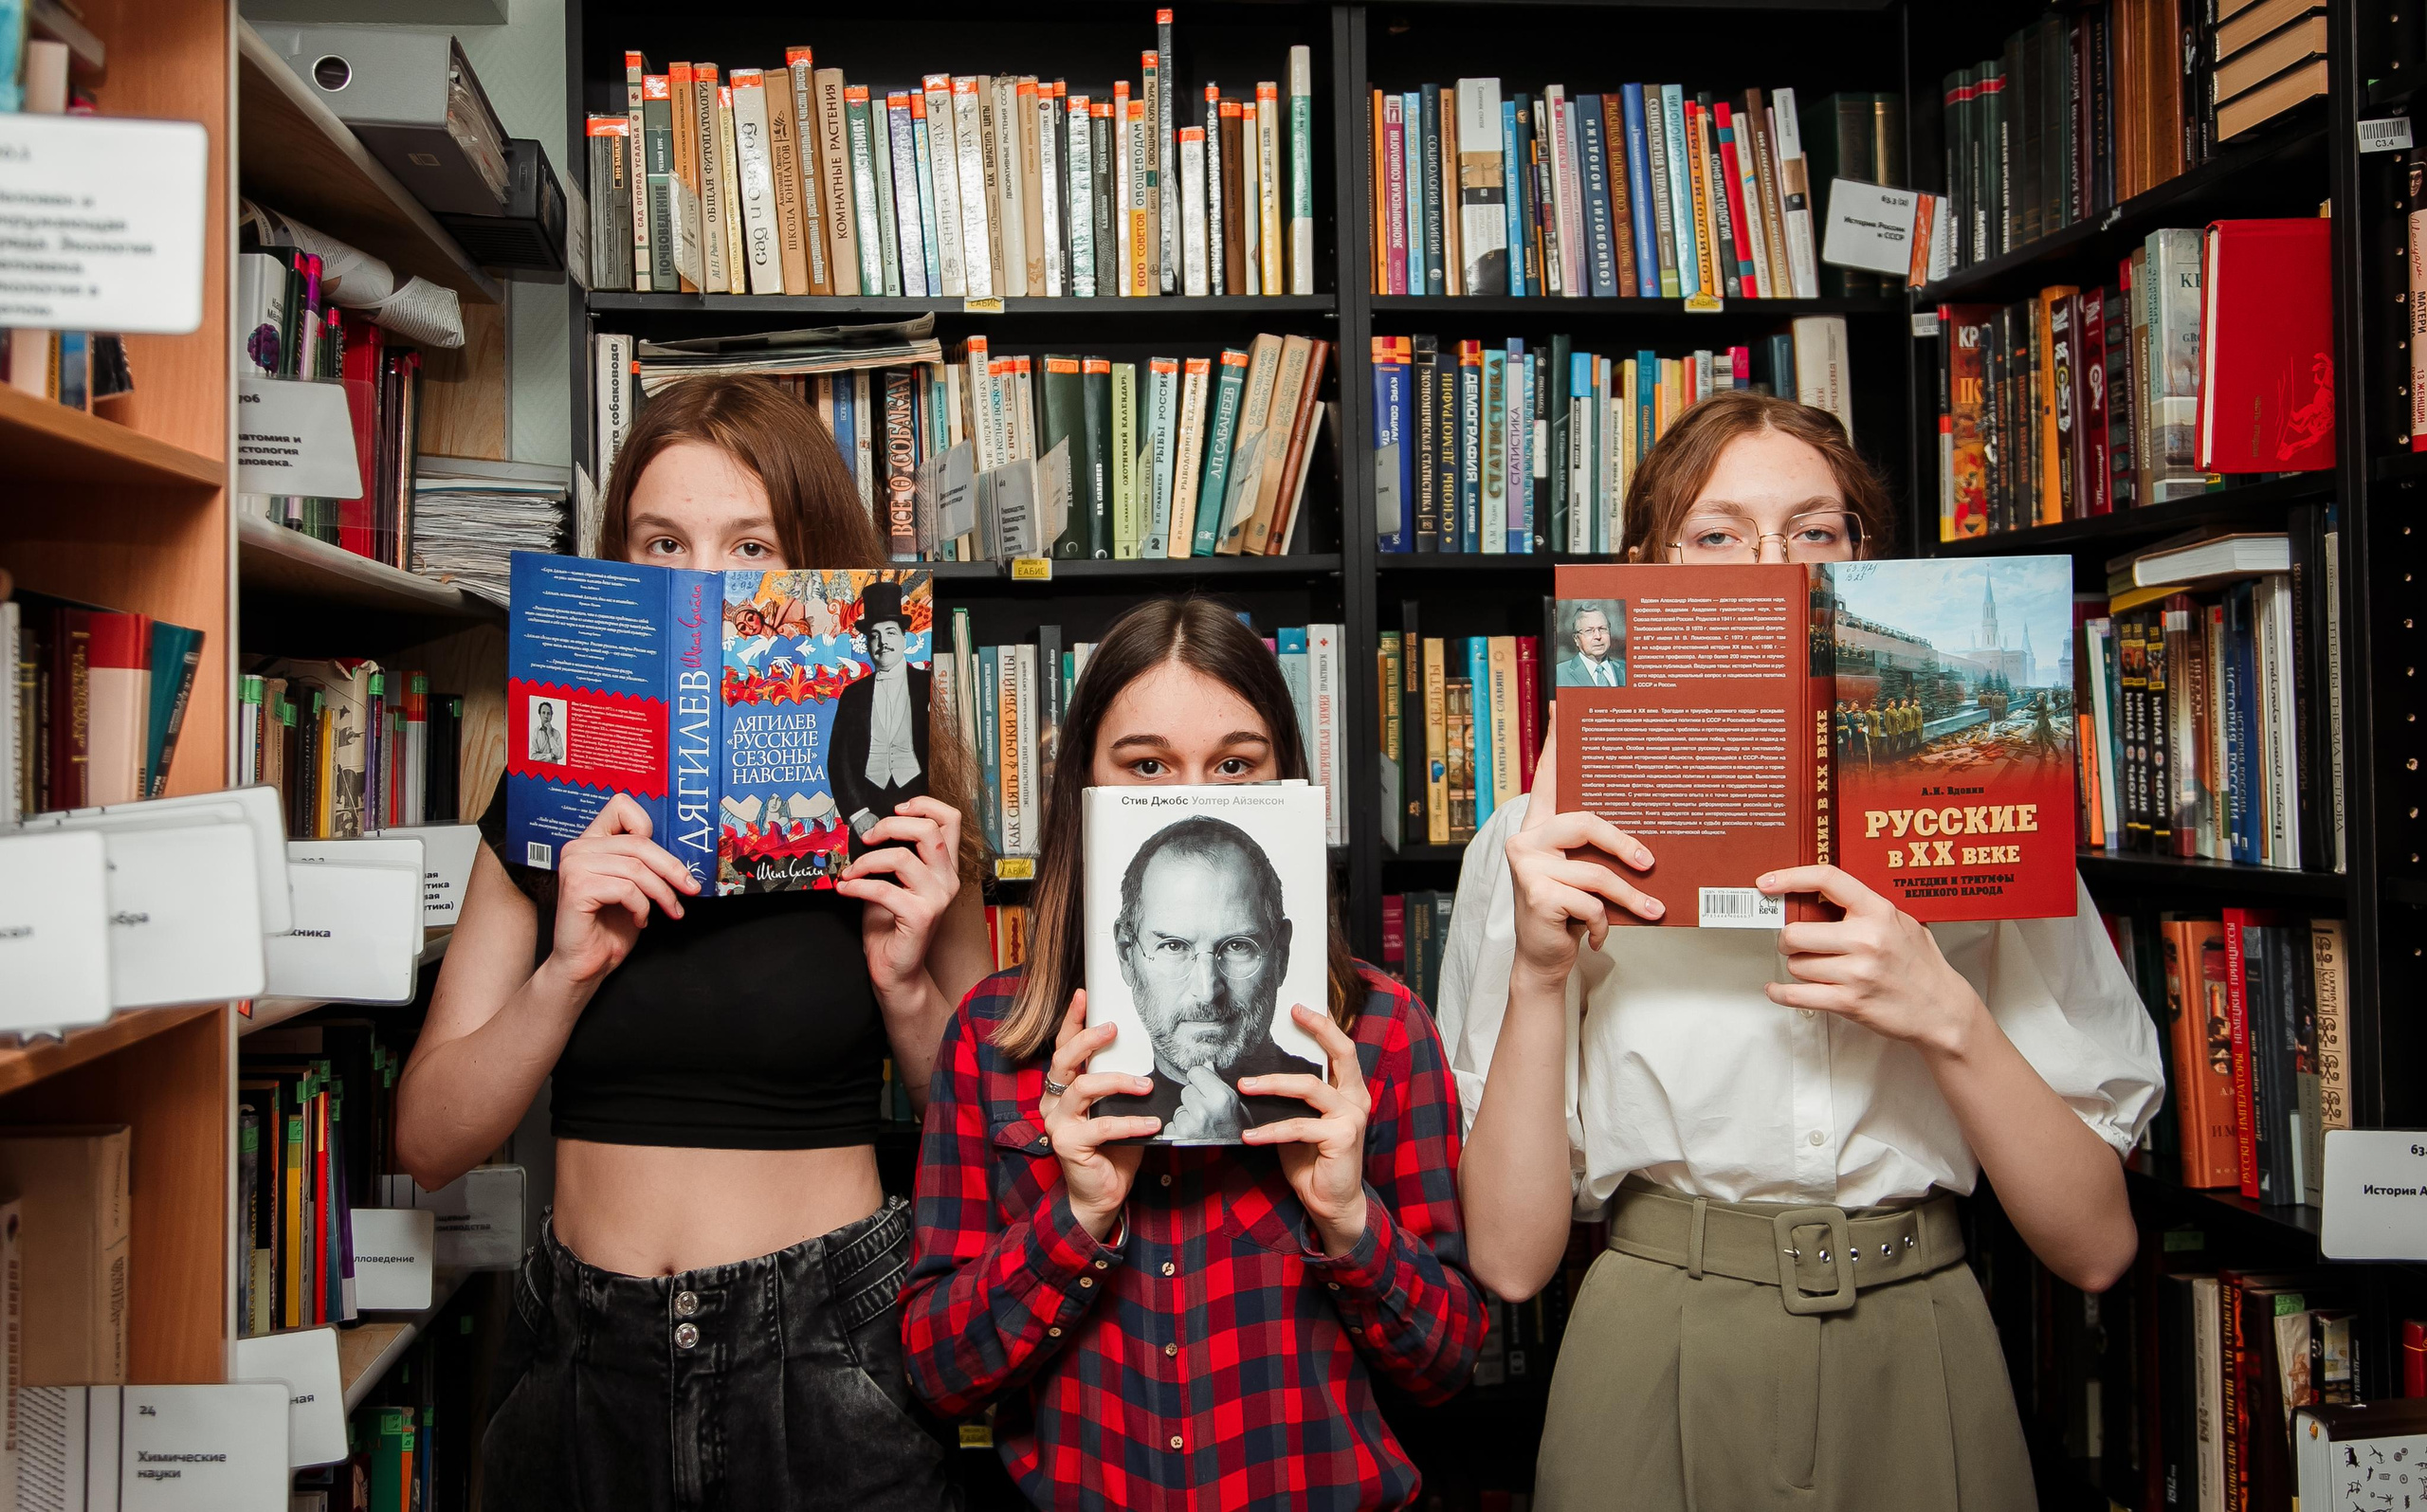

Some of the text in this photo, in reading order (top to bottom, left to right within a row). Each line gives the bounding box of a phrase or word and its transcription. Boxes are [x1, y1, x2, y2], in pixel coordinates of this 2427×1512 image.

[632, 127, 641, 168] УСАДЬБА
[982, 105, 995, 187] КАК ВЫРАСТИТЬ ЦВЕТЫ
[1001, 109, 1010, 143] РАСТЕНИЯ
[825, 84, 848, 239] КОМНАТНЫЕ РАСТЕНИЯ
[1002, 146, 1013, 199] ДЕКОРАТИВНЫЕ
[1608, 101, 1627, 211] СОЦИОЛОГИЯ КУЛЬТУРЫ
[1648, 98, 1671, 231] СОЦИОЛОГИЯ УПРАВЛЕНИЯ
[705, 178, 717, 223] ОБЩАЯ
[776, 172, 785, 206] Анатолий
[781, 145, 797, 250] ШКОЛА ЮННАТОВ
[1134, 123, 1146, 287] 600 СОВЕТОВ ОВОЩЕВОДАМ
[1390, 131, 1403, 248] ЭКОНОМИЧЕСКАЯ СОЦИОЛОГИЯ
[1427, 135, 1440, 254] СОЦИОЛОГИЯ РЕЛИГИИ
[1586, 118, 1611, 286] СОЦИОЛОГИЯ МОЛОДЕЖИ
[1688, 115, 1710, 284] СОЦИОЛОГИЯ СЕМЬИ
[1710, 154, 1732, 240] КОНФЛИКТОЛОГИЯ
[655, 186, 671, 276] ПОЧВОВЕДЕНИЕ
[752, 227, 769, 265] сад
[2417, 291, 2426, 334] МАТЕРИ
[609, 343, 619, 426] собаковода
[1250, 348, 1268, 416] ВСЕХ СОЗДАНИЯХ
[1267, 347, 1277, 377] МАЛЫХ
[976, 351, 992, 446] МЕДОНОСНЫХ ПЧЕЛ
[1155, 372, 1168, 464] РЫБЫ РОССИИ
[1214, 387, 1235, 453] САБАНЕЕВ
[2416, 381, 2425, 423] ЖЕНЩИН
[1007, 422, 1015, 448] пчел
[1421, 369, 1433, 511] ЭКОНОМИЧЕСКАЯ СТАТИСТИКА
[1441, 373, 1455, 532] ОСНОВЫ ДЕМОГРАФИИ
[1465, 373, 1478, 483] ДЕМОГРАФИЯ
[1487, 358, 1503, 499] СТАТИСТИКА
[1510, 407, 1522, 485] СТАТИСТИКА
[238, 457, 293, 467] еловека.
[886, 377, 914, 537] ВСЕ О СОБАКАХ
[1121, 431, 1129, 485] ОХОТНИЧИЙ
[1017, 565, 1045, 575] ЕАБИС
[1151, 538, 1160, 550] 2
[2292, 562, 2304, 625] ИСТОРИЯ
[1320, 695, 1330, 725] ХИМИЯ
[1430, 664, 1442, 725] КЕЛЬТЫ
[2126, 692, 2135, 739] БУНИЧ
[727, 732, 818, 750] «РУССКИЕ
[734, 714, 816, 735] ДЯГИЛЕВ
[1002, 655, 1020, 847] КАК СНЯТЬ ОЧКИ-УБИЙЦЫ
[1817, 710, 1828, 757] ВЕКЕ
[2135, 692, 2148, 811] ИГОРЬ БУНИЧ
[2226, 666, 2240, 820] ИСТОРИЯ РОССИИ
[2328, 621, 2345, 833] ПТЕНЦЫ ГНЕЗДА ПЕТРОВА
[678, 670, 714, 853] ДЯГИЛЕВ
[732, 749, 818, 767] СЕЗОНЫ»
[732, 766, 826, 785] НАВСЕГДА
[2152, 696, 2165, 817] ИГОРЬ БУНИЧ
[1122, 795, 1285, 808] Стив Джобс Уолтер Айзексон
[1947, 786, 1984, 796] Вдовин
[2127, 764, 2137, 811] ИГОРЬ
[1865, 804, 2038, 838] РУССКИЕ
[1893, 874, 2015, 888] ТРАГЕДИИ ТРИУМФЫ
[1962, 845, 2020, 865] ВЕКЕ
[1905, 884, 2003, 899] ВЕЛИКОГО НАРОДА
[291, 926, 332, 939] хника
[2226, 922, 2252, 1184] РУССКИЕ НЕМЕЦКИЕ ПРИНЦЕССЫ
[2363, 1184, 2417, 1197] История
[354, 1253, 415, 1266] лловедение
[2222, 1285, 2232, 1345] СТОЛЕТИЯ
[138, 1404, 156, 1417] 24
[2224, 1378, 2235, 1434] ИСТОРИИ
[137, 1450, 228, 1466] Химические
[137, 1466, 182, 1482] науки
